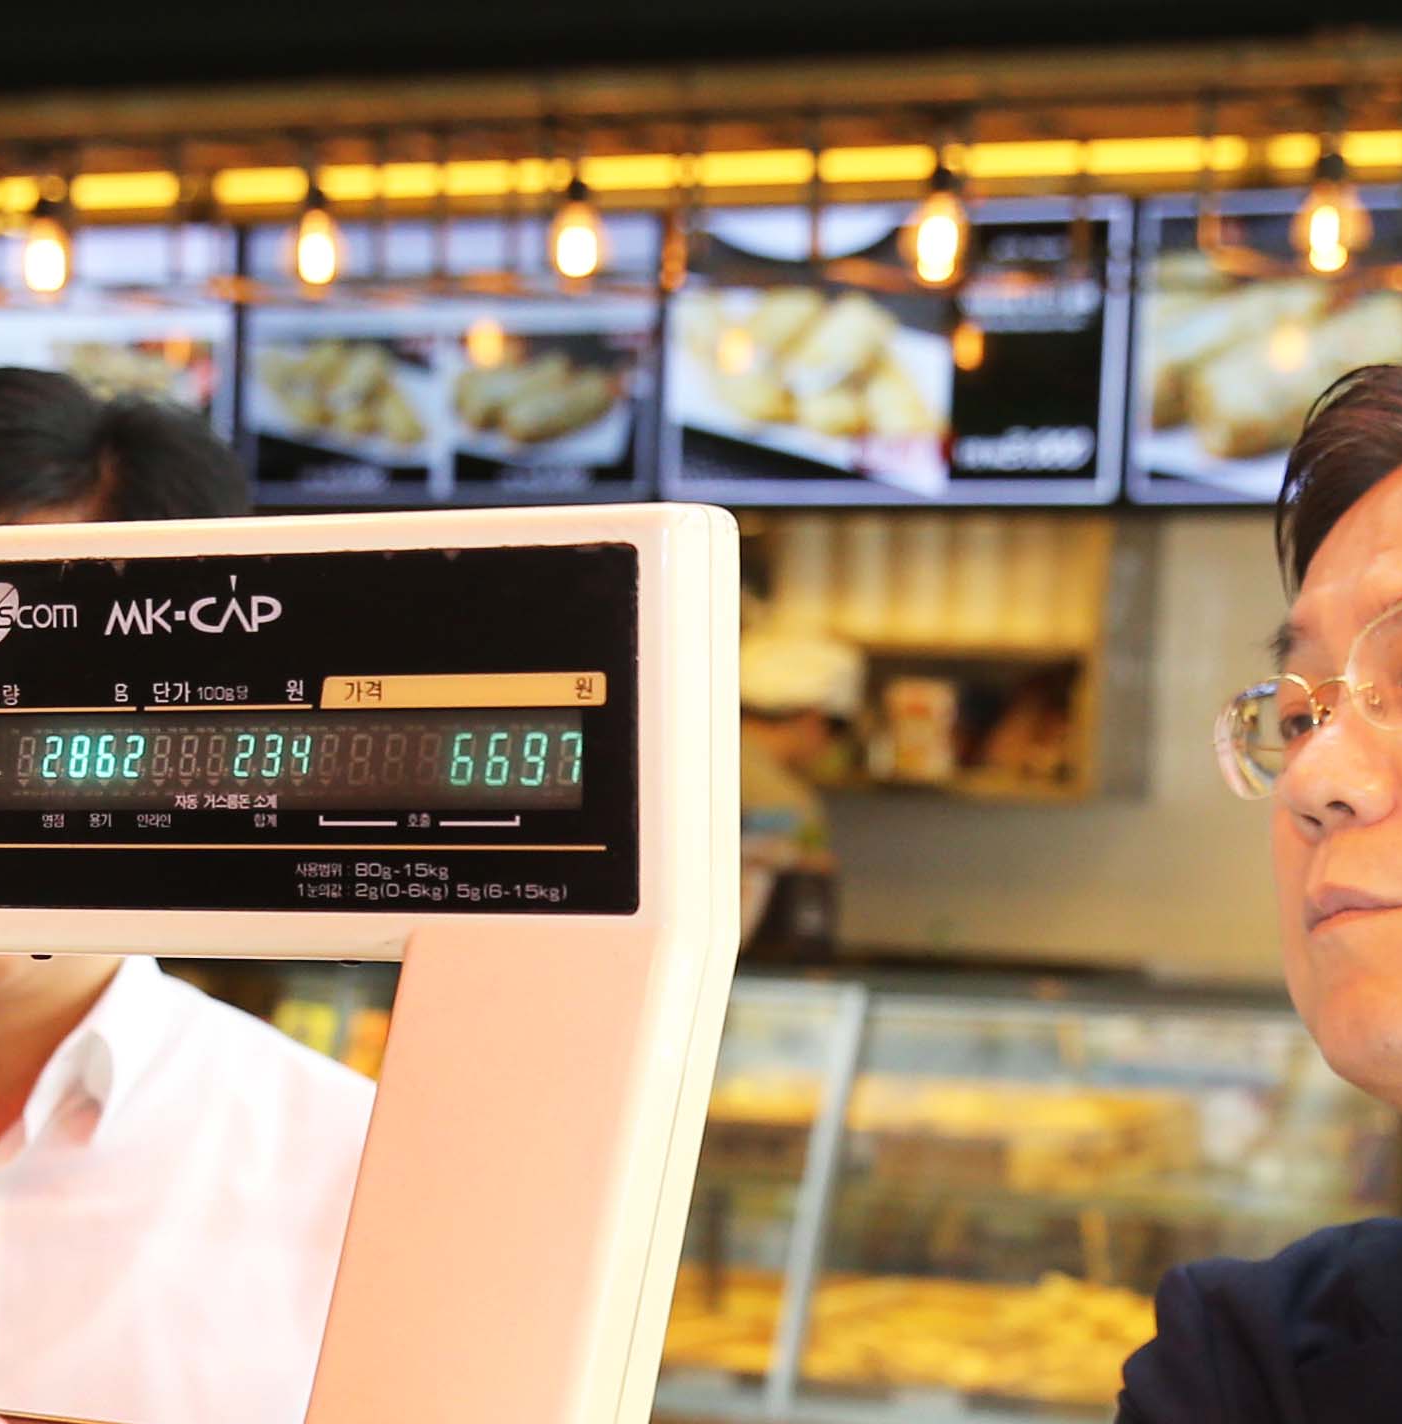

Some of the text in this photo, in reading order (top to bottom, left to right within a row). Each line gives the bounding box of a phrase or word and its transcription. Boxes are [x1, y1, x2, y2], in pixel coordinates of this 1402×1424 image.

[152, 682, 191, 703] 단가
[286, 679, 305, 702] 원
[344, 677, 593, 702] 가격 원
[40, 734, 146, 779] 2862
[232, 733, 312, 779] 234
[449, 731, 583, 787] 6697
[174, 794, 278, 810] 자동 거스름돈 소계
[41, 813, 66, 829] 영점
[88, 813, 113, 829] 용기
[136, 813, 172, 829] 인라인
[354, 862, 450, 880] 80g-15kg
[456, 883, 568, 902] 5g(6-15kg)
